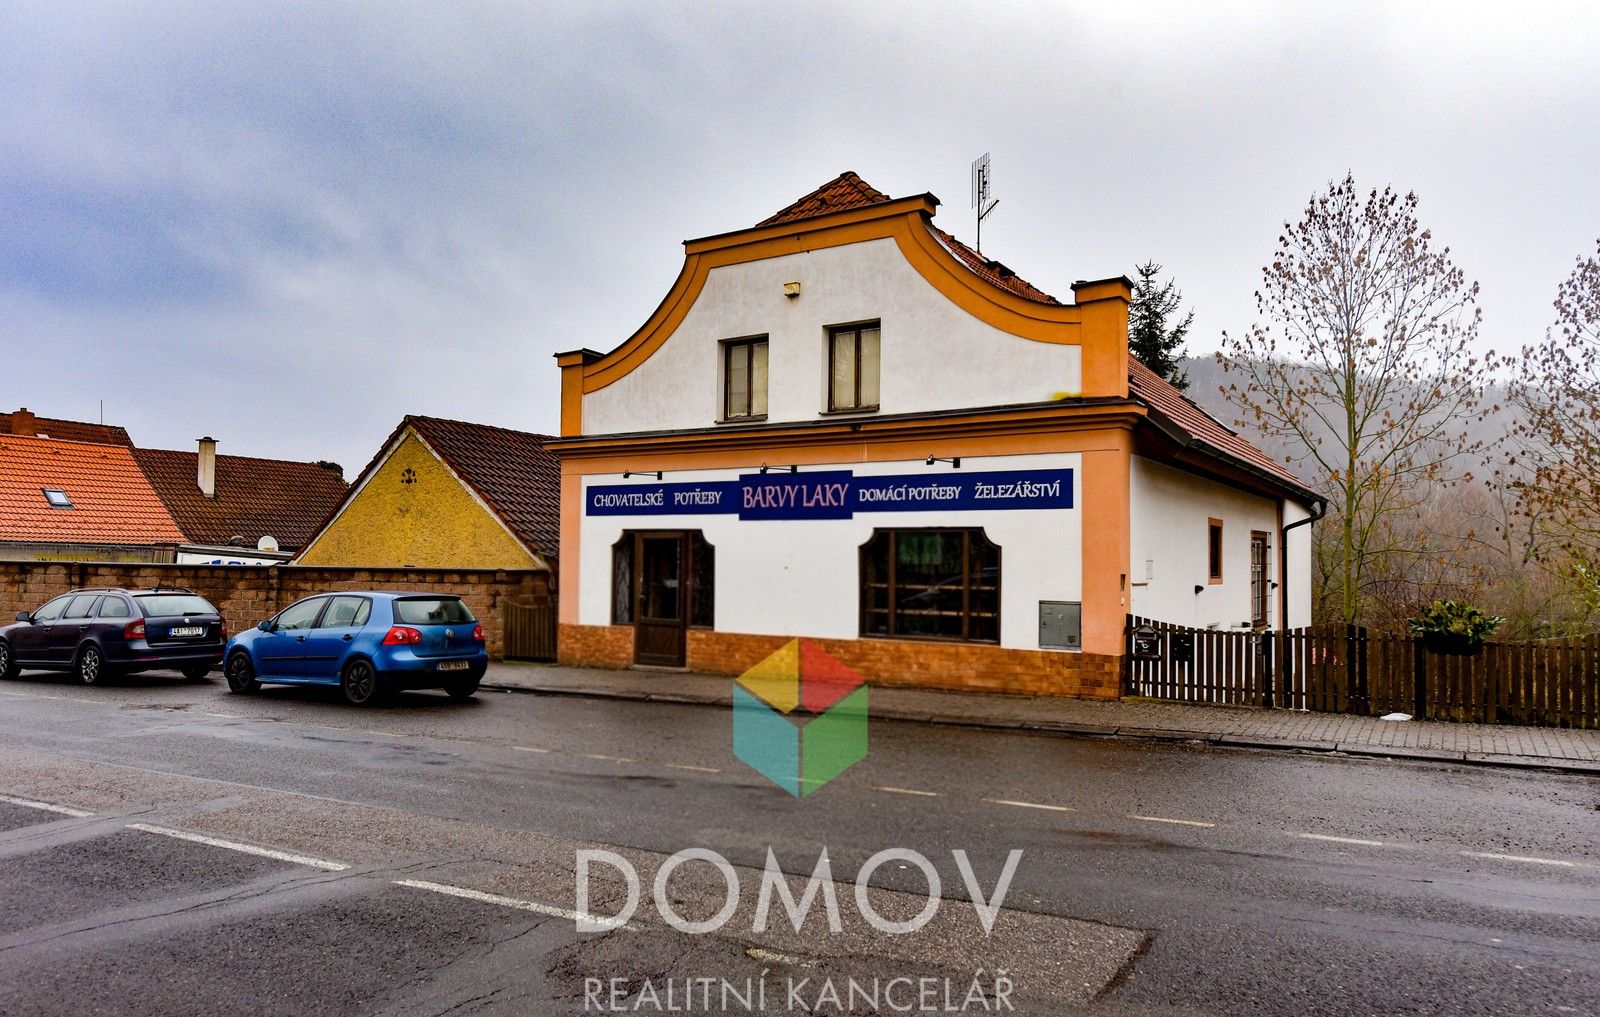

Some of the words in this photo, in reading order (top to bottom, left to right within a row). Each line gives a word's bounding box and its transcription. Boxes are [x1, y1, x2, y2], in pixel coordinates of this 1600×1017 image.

[594, 489, 664, 507] CHOVATELSKÉ
[674, 488, 722, 505] POTŘEBY
[742, 485, 799, 508] BARVY
[801, 483, 849, 507] LAKY
[859, 485, 906, 502] DOMÁCÍ
[907, 484, 962, 500] POTŘEBY
[974, 480, 1061, 499] ŽELEZÁŘSTVÍ
